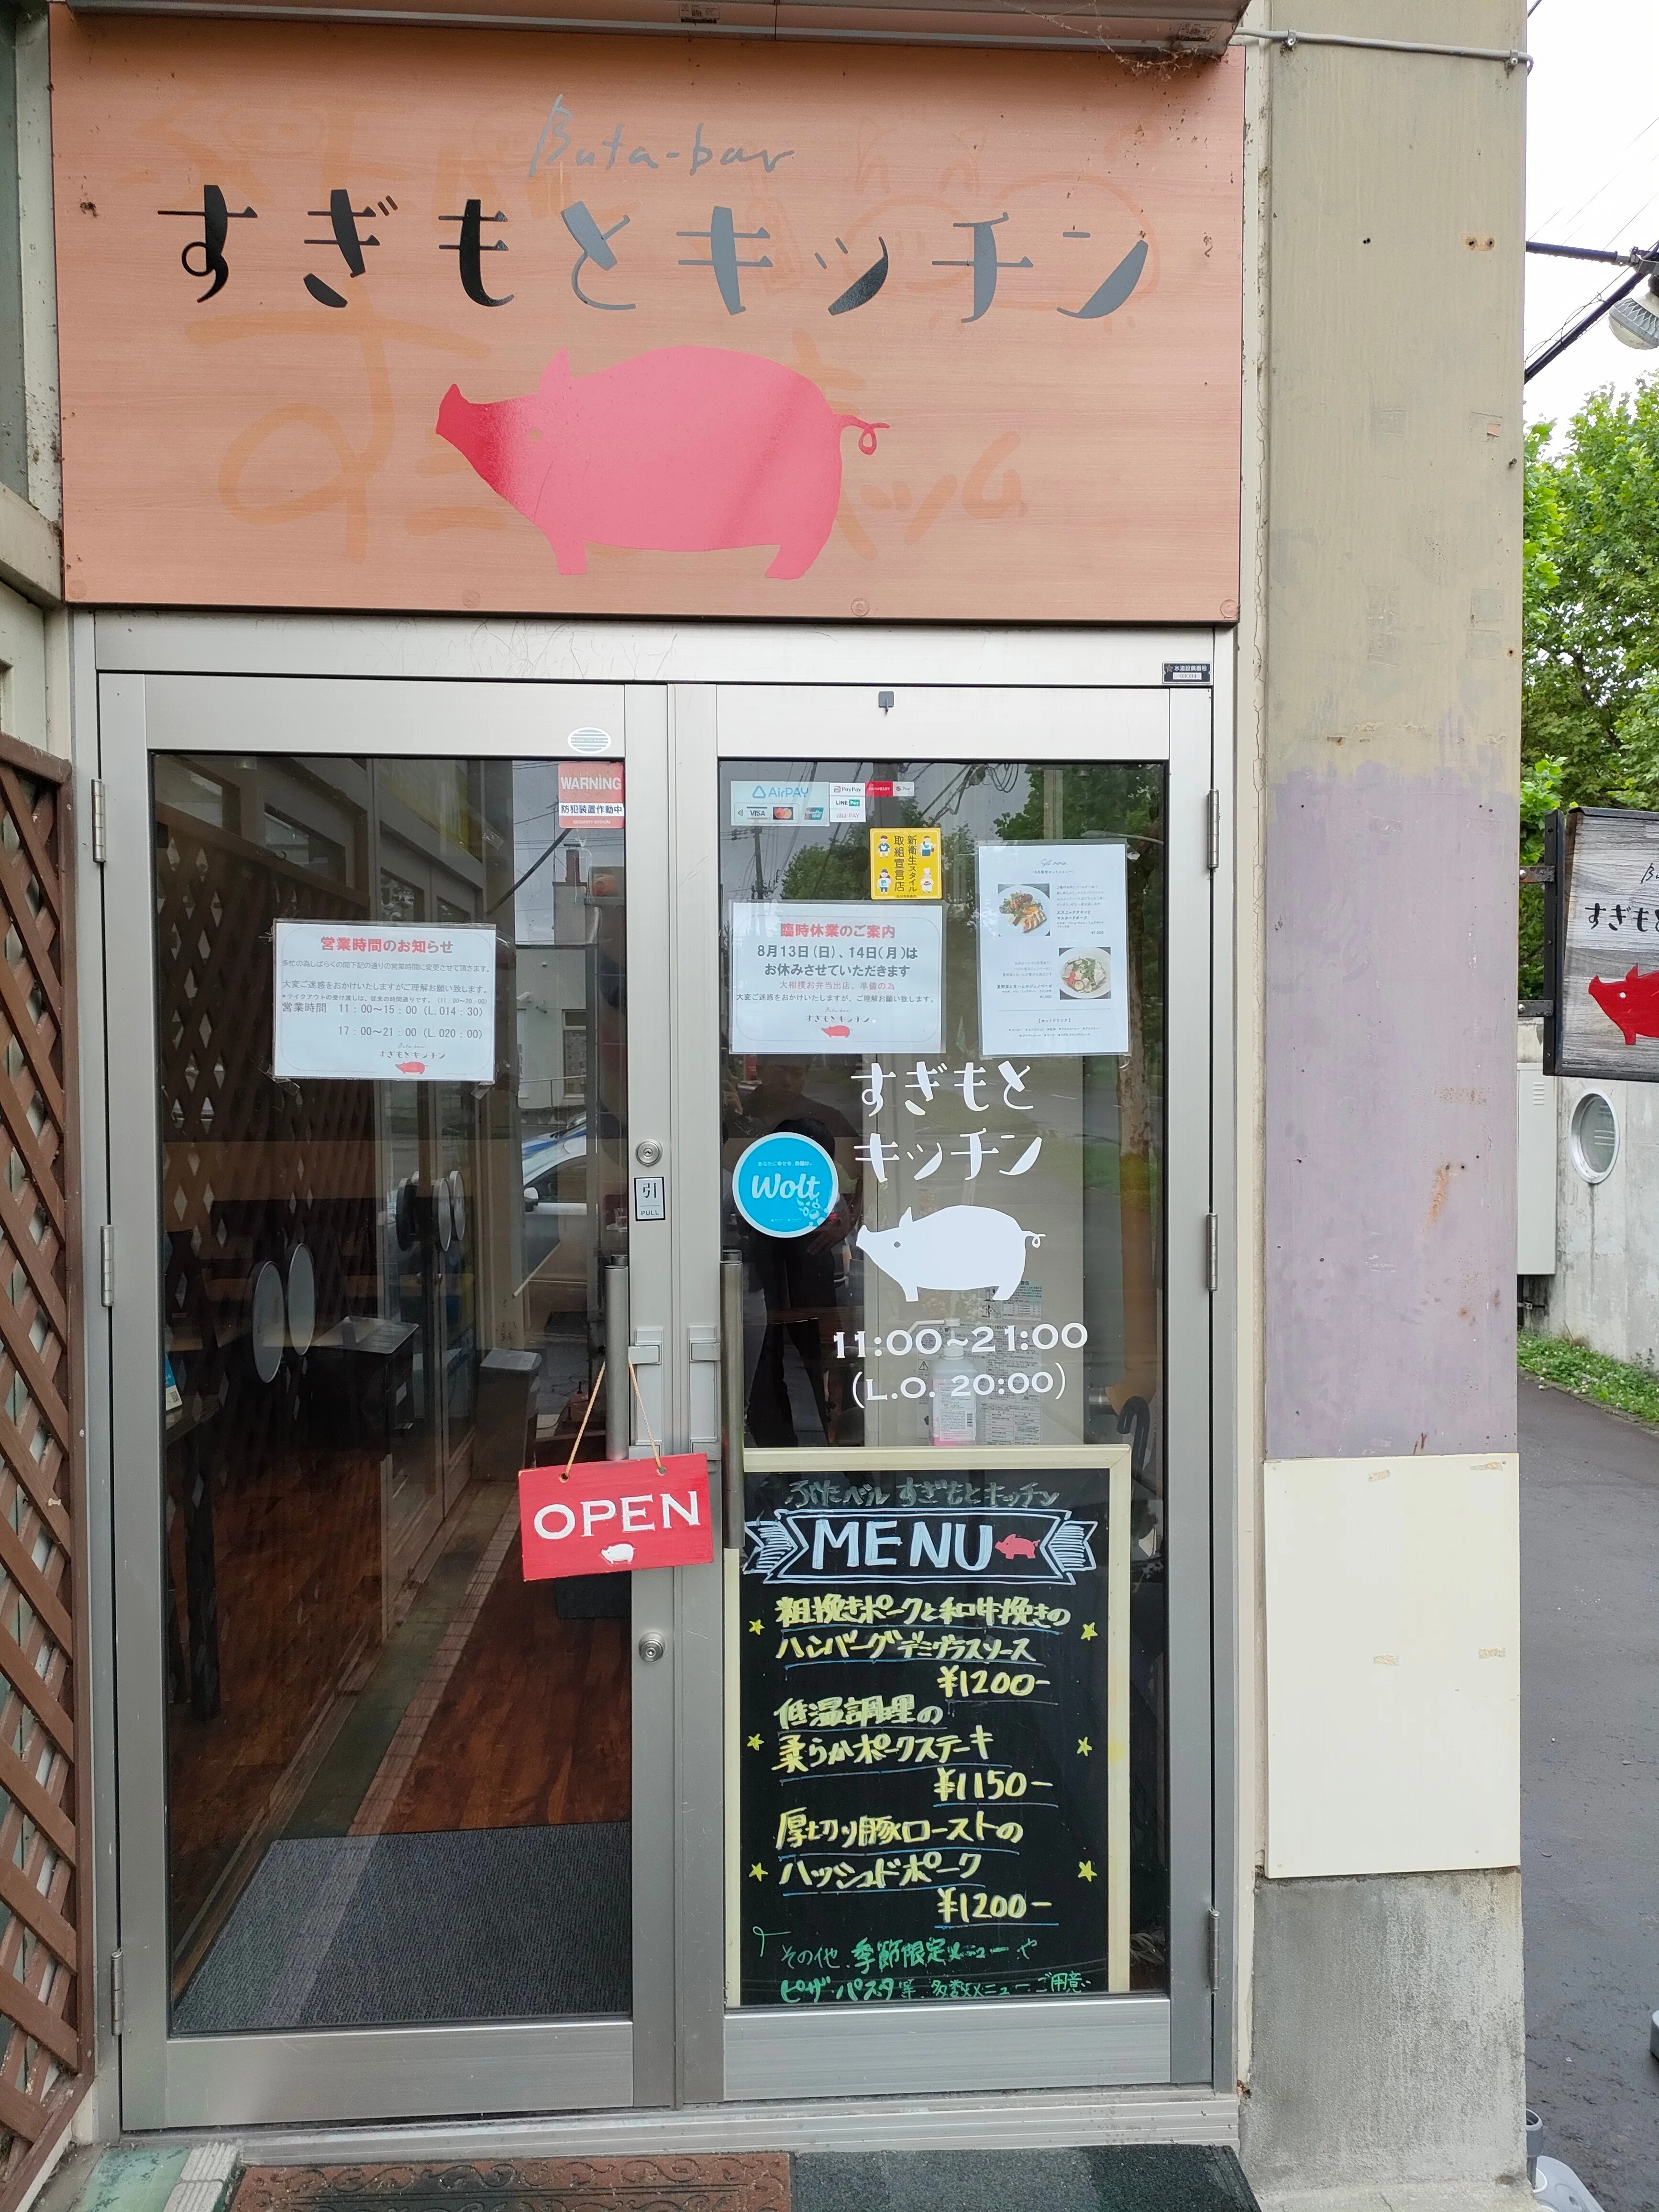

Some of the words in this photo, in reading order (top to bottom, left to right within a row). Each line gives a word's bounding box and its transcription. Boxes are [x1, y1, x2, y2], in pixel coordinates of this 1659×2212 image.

[157, 184, 1149, 323] すぎもとキッチン
[561, 777, 622, 790] WARNING
[768, 787, 809, 797] AirPAY
[561, 805, 622, 814] 防犯装置作動中
[894, 835, 905, 892] 取組宣言店
[907, 834, 918, 892] 新衛生スタイル
[320, 936, 454, 954] 営業時間のお知らせ
[780, 923, 896, 939] 臨時休業のご案内
[282, 959, 490, 973] 多忙の為しばらくの間下記の通りの営業時間に変更させて頂きます。
[764, 963, 910, 977] お休みさせていただきます
[282, 980, 487, 994] 大変ご迷惑をおかけいたしますがご理解お願い致します。
[736, 993, 935, 1004] 大変ご迷惑をおかけいたしますが、ご理解お願い致します。
[779, 980, 896, 990] 大相撲お弁当出店、準備の為
[282, 1002, 327, 1013] 営業時間
[805, 1014, 870, 1023] すぎもとキッチン
[378, 1050, 446, 1059] すぎもとキッチン
[851, 1061, 1034, 1117] すぎもと
[853, 1128, 1043, 1183] キッチン
[643, 1183, 657, 1199] 引
[752, 1173, 821, 1201] Wolt
[852, 1371, 936, 1408] (L.O.
[951, 1362, 1066, 1400] 20:00)
[896, 1477, 1060, 1508] すぎもとキッチン
[534, 1491, 701, 1540] OPEN
[812, 1519, 993, 1571] MENU
[774, 1593, 1071, 1627] 粗挽きポークと和牛挽きの
[774, 1694, 943, 1729] 低温調理の
[772, 1725, 994, 1774] 柔らかポークステーキ
[775, 1806, 1024, 1850] 厚切り豚ローストの
[779, 1851, 982, 1889] ハッシュドポーク
